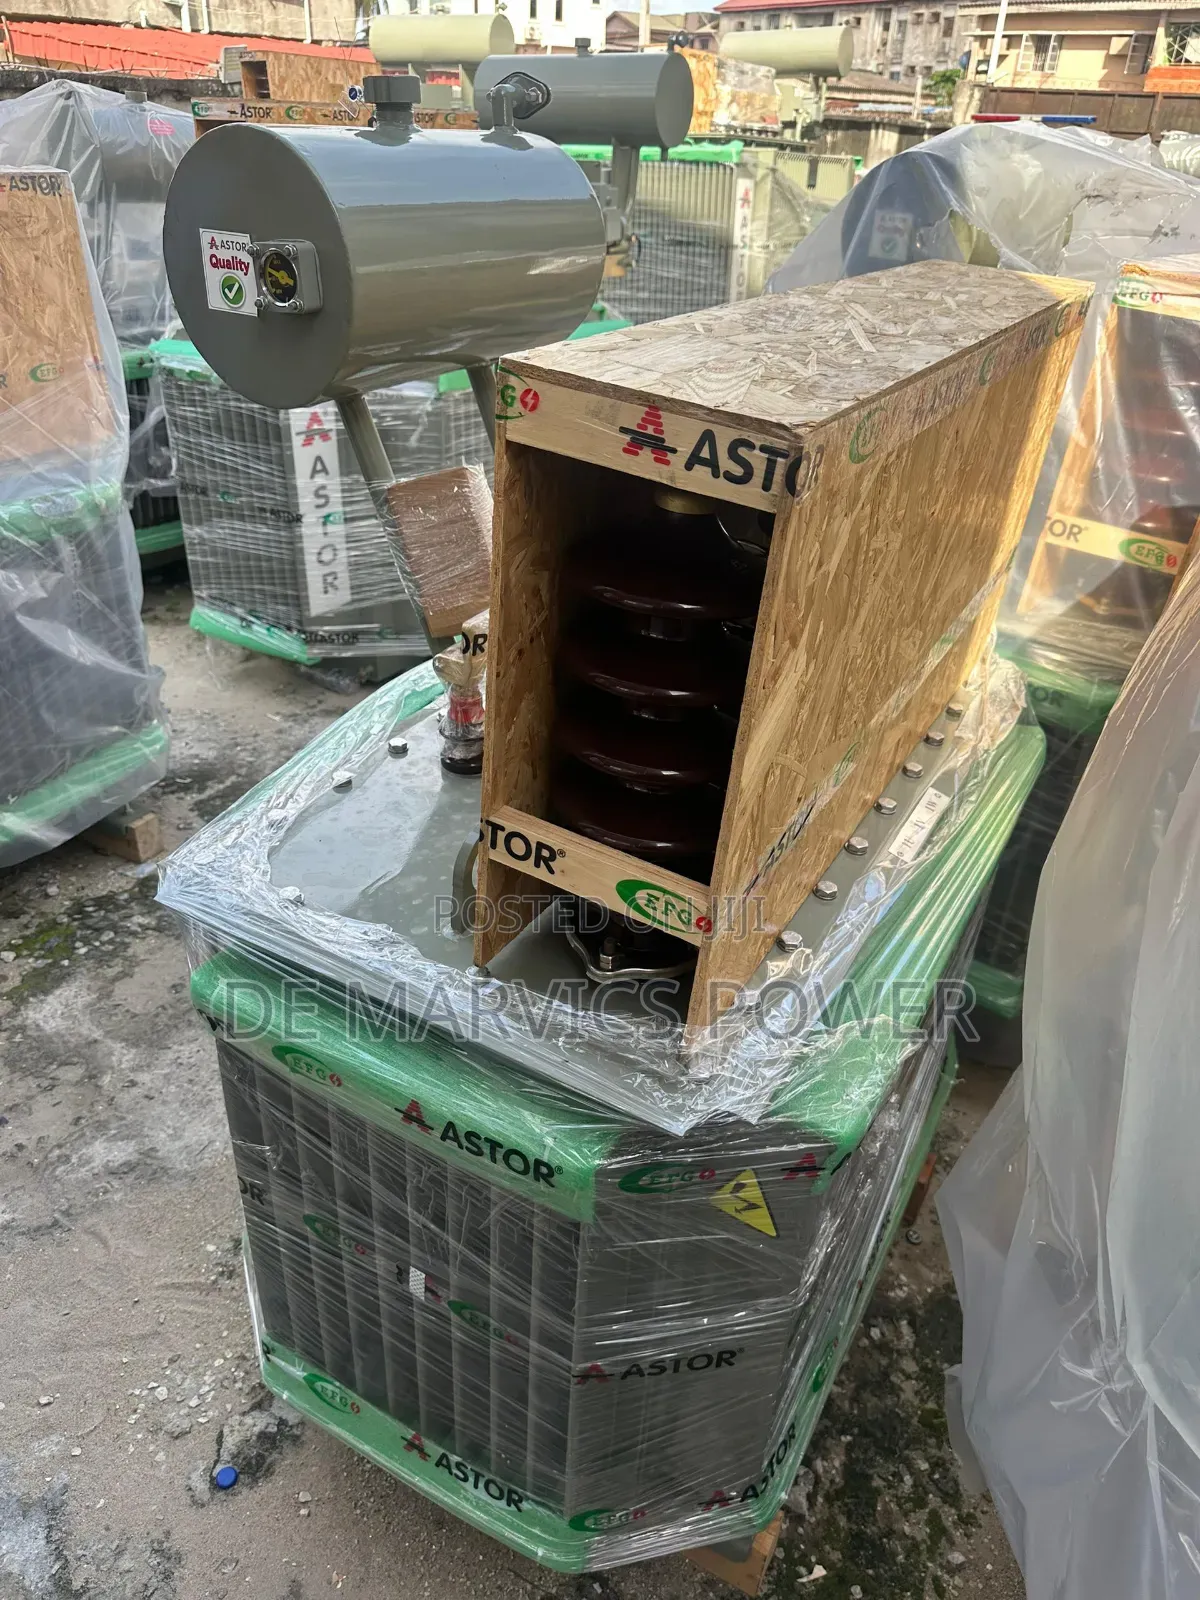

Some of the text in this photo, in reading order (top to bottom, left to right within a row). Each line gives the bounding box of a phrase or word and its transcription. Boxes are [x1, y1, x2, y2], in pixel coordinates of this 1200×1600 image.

[240, 103, 272, 119] ASTOR
[220, 239, 248, 252] ASTOR
[209, 253, 251, 277] Quality
[1046, 517, 1083, 544] OR
[434, 1452, 524, 1513] ASTOR
